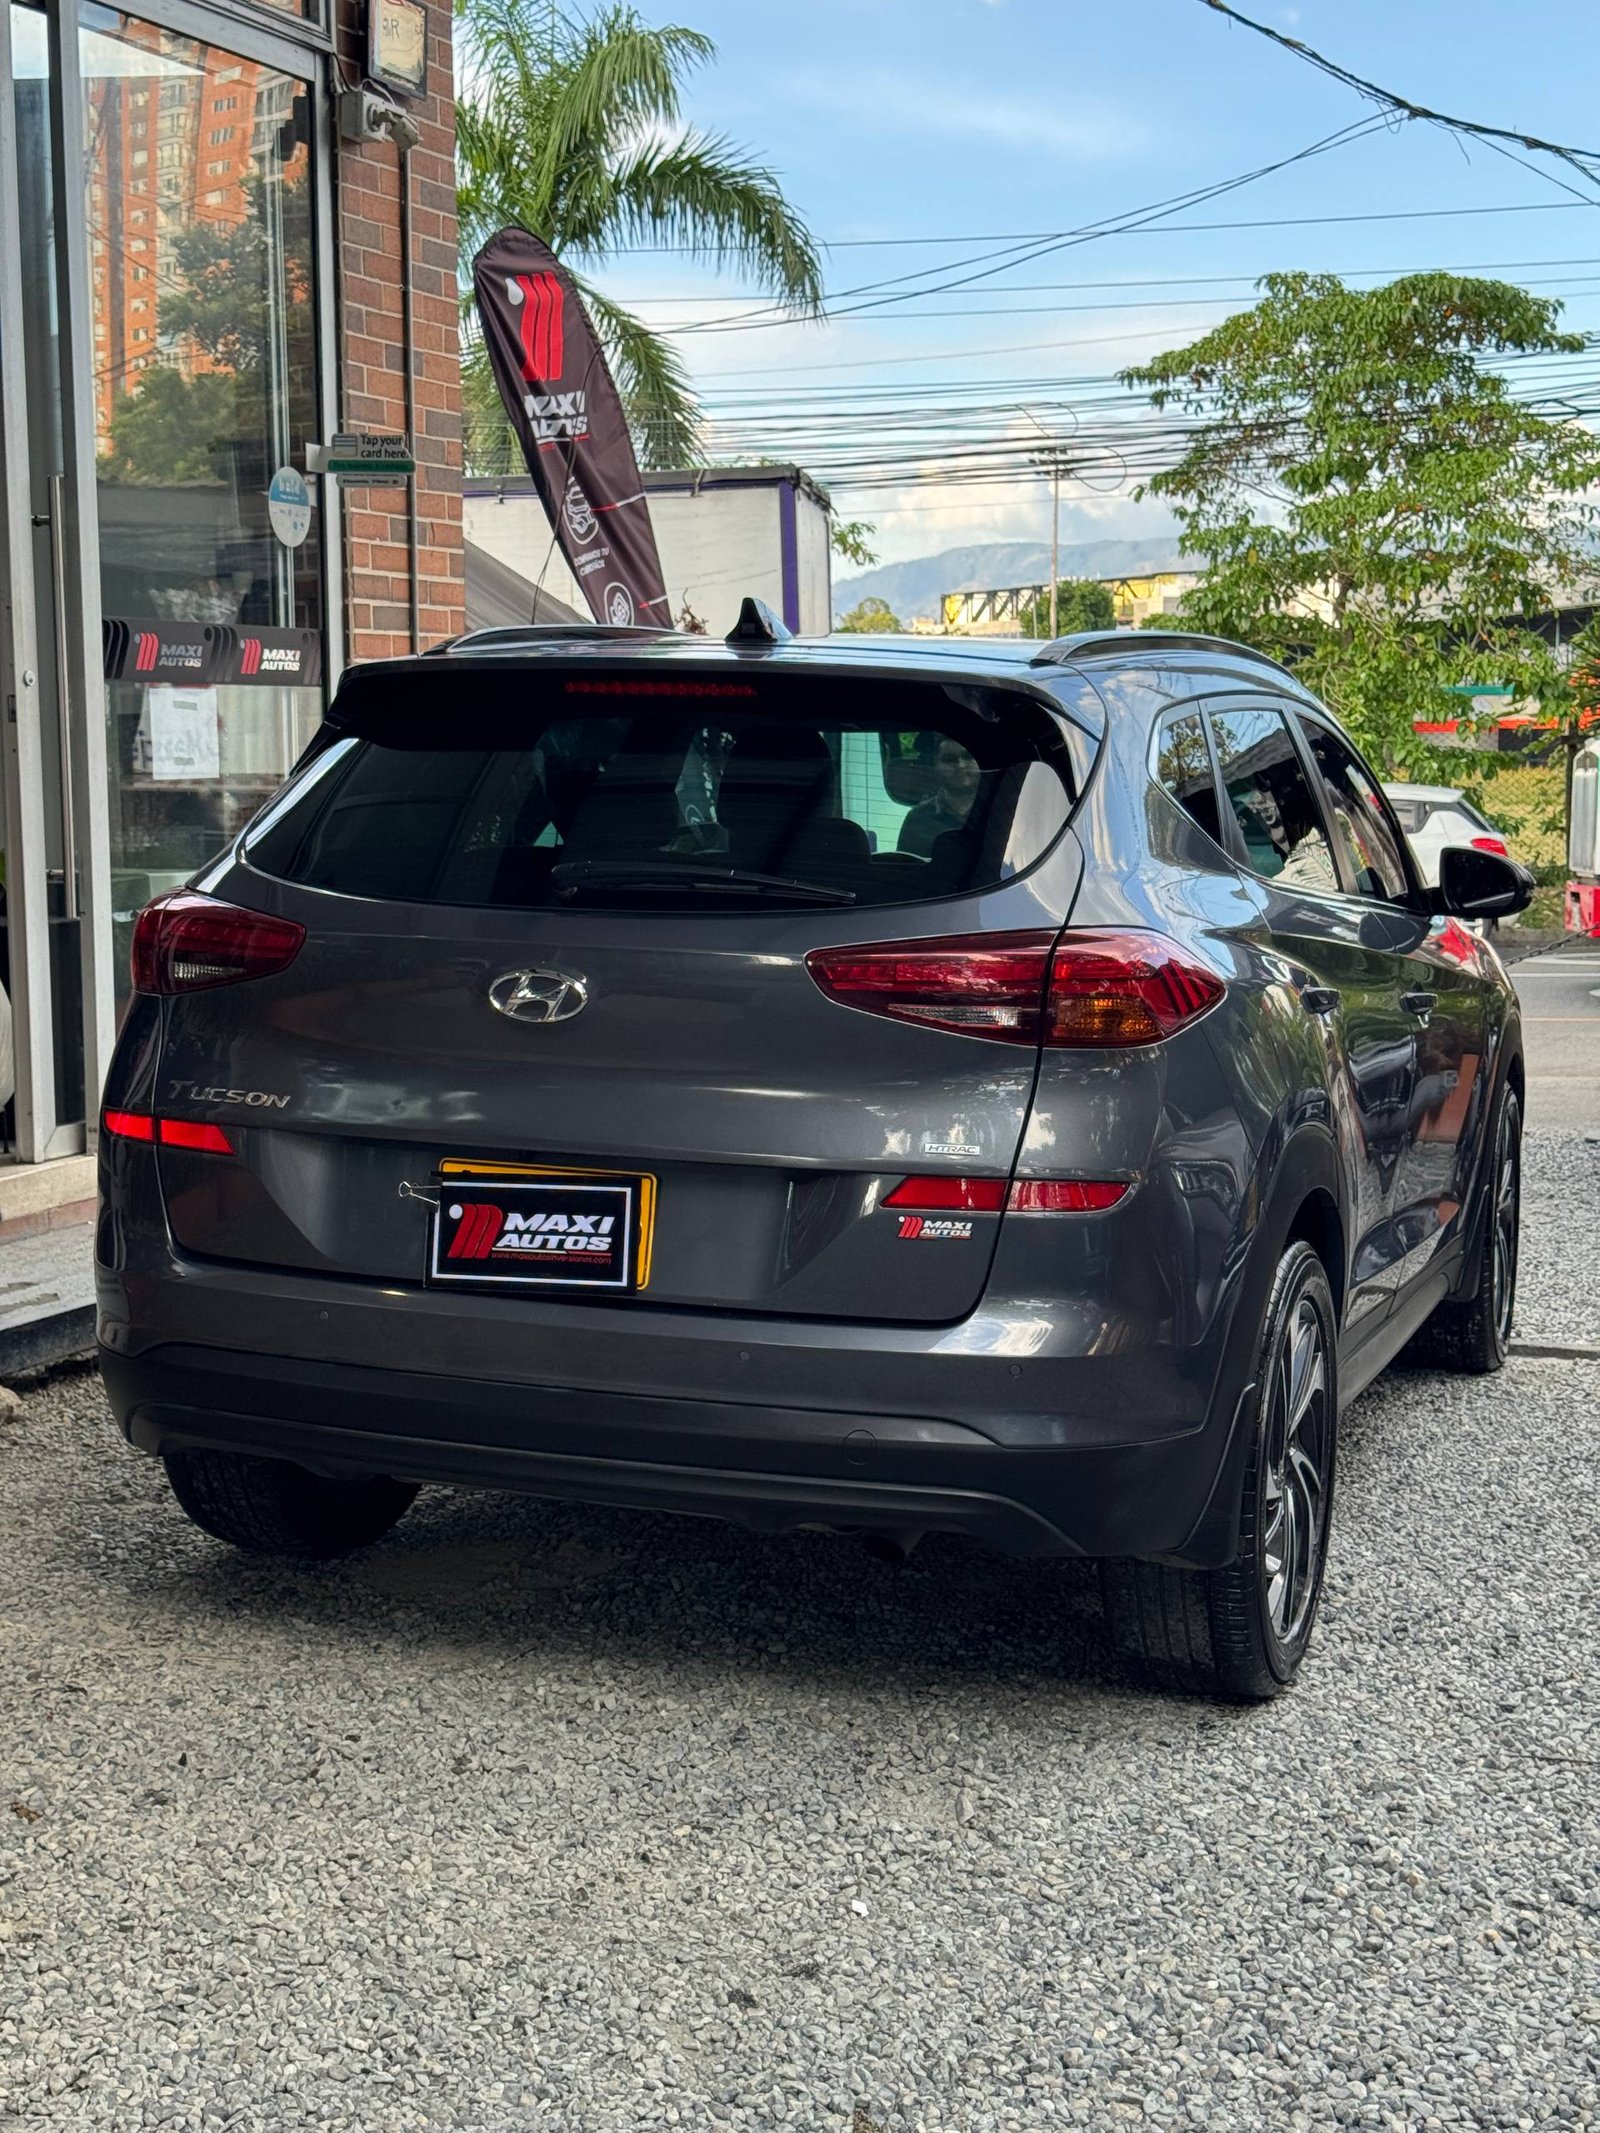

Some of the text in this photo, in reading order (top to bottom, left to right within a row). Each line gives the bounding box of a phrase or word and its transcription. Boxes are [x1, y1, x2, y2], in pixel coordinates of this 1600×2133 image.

[361, 434, 403, 447] Tap your
[361, 449, 382, 458] card
[160, 644, 203, 657] MAXI
[262, 648, 301, 661] MAXI
[158, 656, 203, 669] AUTOS
[260, 660, 301, 672] AUTOS
[168, 1080, 291, 1109] TUCSON
[929, 1145, 976, 1154] HTRAC
[504, 1212, 615, 1234] MAXI
[923, 1221, 973, 1230] MAXI
[495, 1233, 612, 1251] AUTOS
